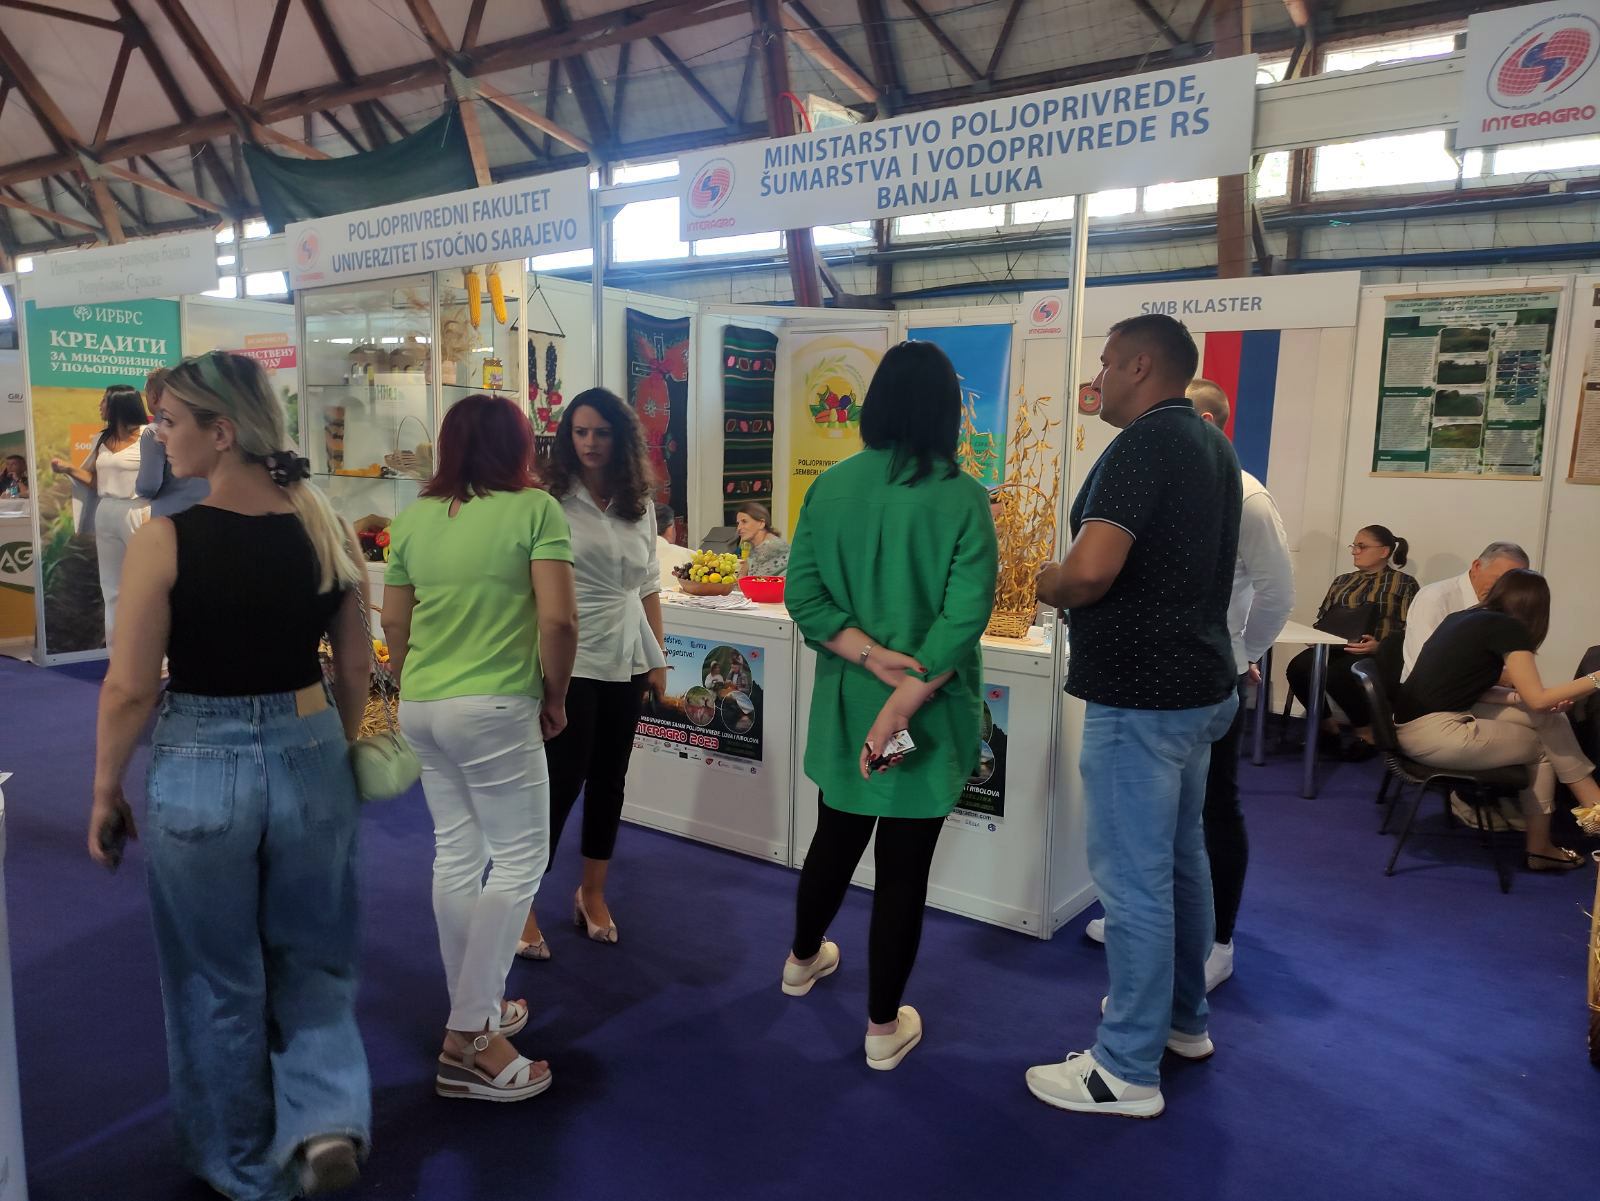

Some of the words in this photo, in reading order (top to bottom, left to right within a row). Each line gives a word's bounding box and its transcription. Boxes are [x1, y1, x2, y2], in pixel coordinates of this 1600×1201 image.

[764, 119, 941, 169] MINISTARSTVO
[951, 75, 1206, 140] POLJOPRIVREDE,
[1481, 105, 1596, 132] INTERAGRO
[760, 155, 901, 197] ŠUMARSTVA
[911, 152, 918, 176] I
[927, 115, 1157, 174] VODOPRIVREDE
[1170, 107, 1210, 138] RS
[876, 177, 959, 210] BANJA
[970, 165, 1043, 198] LUKA
[348, 203, 469, 242] POLJOPRIVREDNI
[472, 187, 551, 221] FAKULTET
[686, 216, 736, 233] INTERAGRO
[332, 241, 418, 273] UNIVERZITET
[421, 231, 488, 261] ISTOČNO
[491, 218, 577, 250] SARAJEVO
[95, 307, 143, 325] ИРБРС
[1141, 300, 1177, 315] SMB
[1182, 296, 1262, 314] KLASTER
[50, 330, 168, 354] КРЕДИТИ
[50, 351, 66, 361] ЗА
[71, 353, 167, 368] МИКРОБИЗНИС
[50, 362, 60, 371] У
[62, 362, 149, 377] ПОЉОПРИВРЕ
[635, 721, 688, 743] NTERAGRO
[689, 732, 720, 750] 2023
